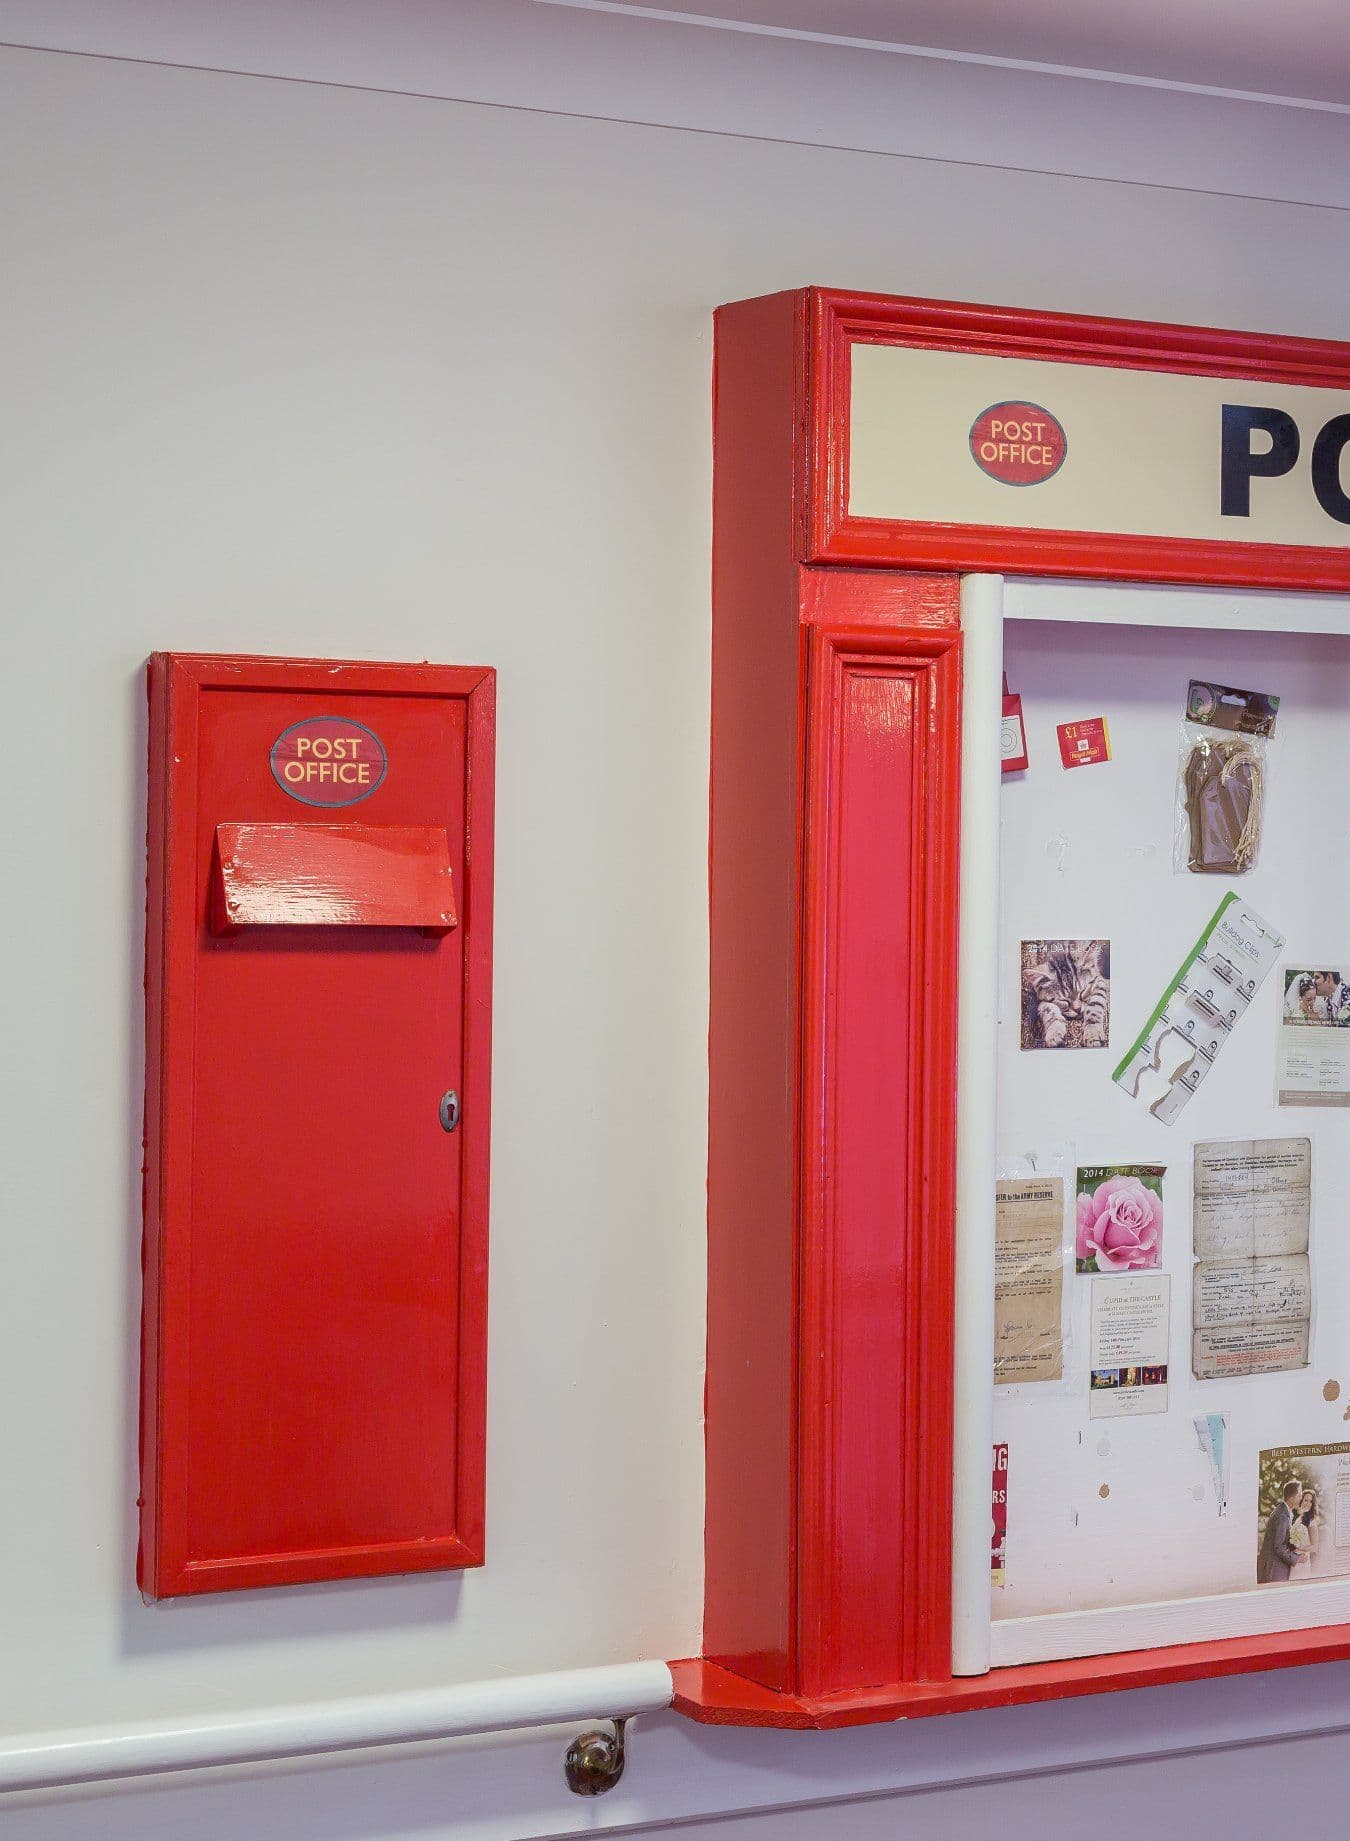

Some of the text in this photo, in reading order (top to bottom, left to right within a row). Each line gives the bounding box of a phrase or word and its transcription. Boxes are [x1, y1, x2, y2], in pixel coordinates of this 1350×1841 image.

[990, 420, 1046, 443] POST
[980, 442, 1053, 466] OFFICE
[296, 738, 362, 759] POST
[284, 761, 370, 784] OFFICE
[1221, 921, 1245, 946] Bulldog
[1083, 1169, 1104, 1178] 2014
[1106, 1168, 1130, 1176] DATE
[1020, 1192, 1034, 1200] ARMY
[1034, 1190, 1053, 1199] RESERVE
[1272, 1450, 1286, 1458] BEST
